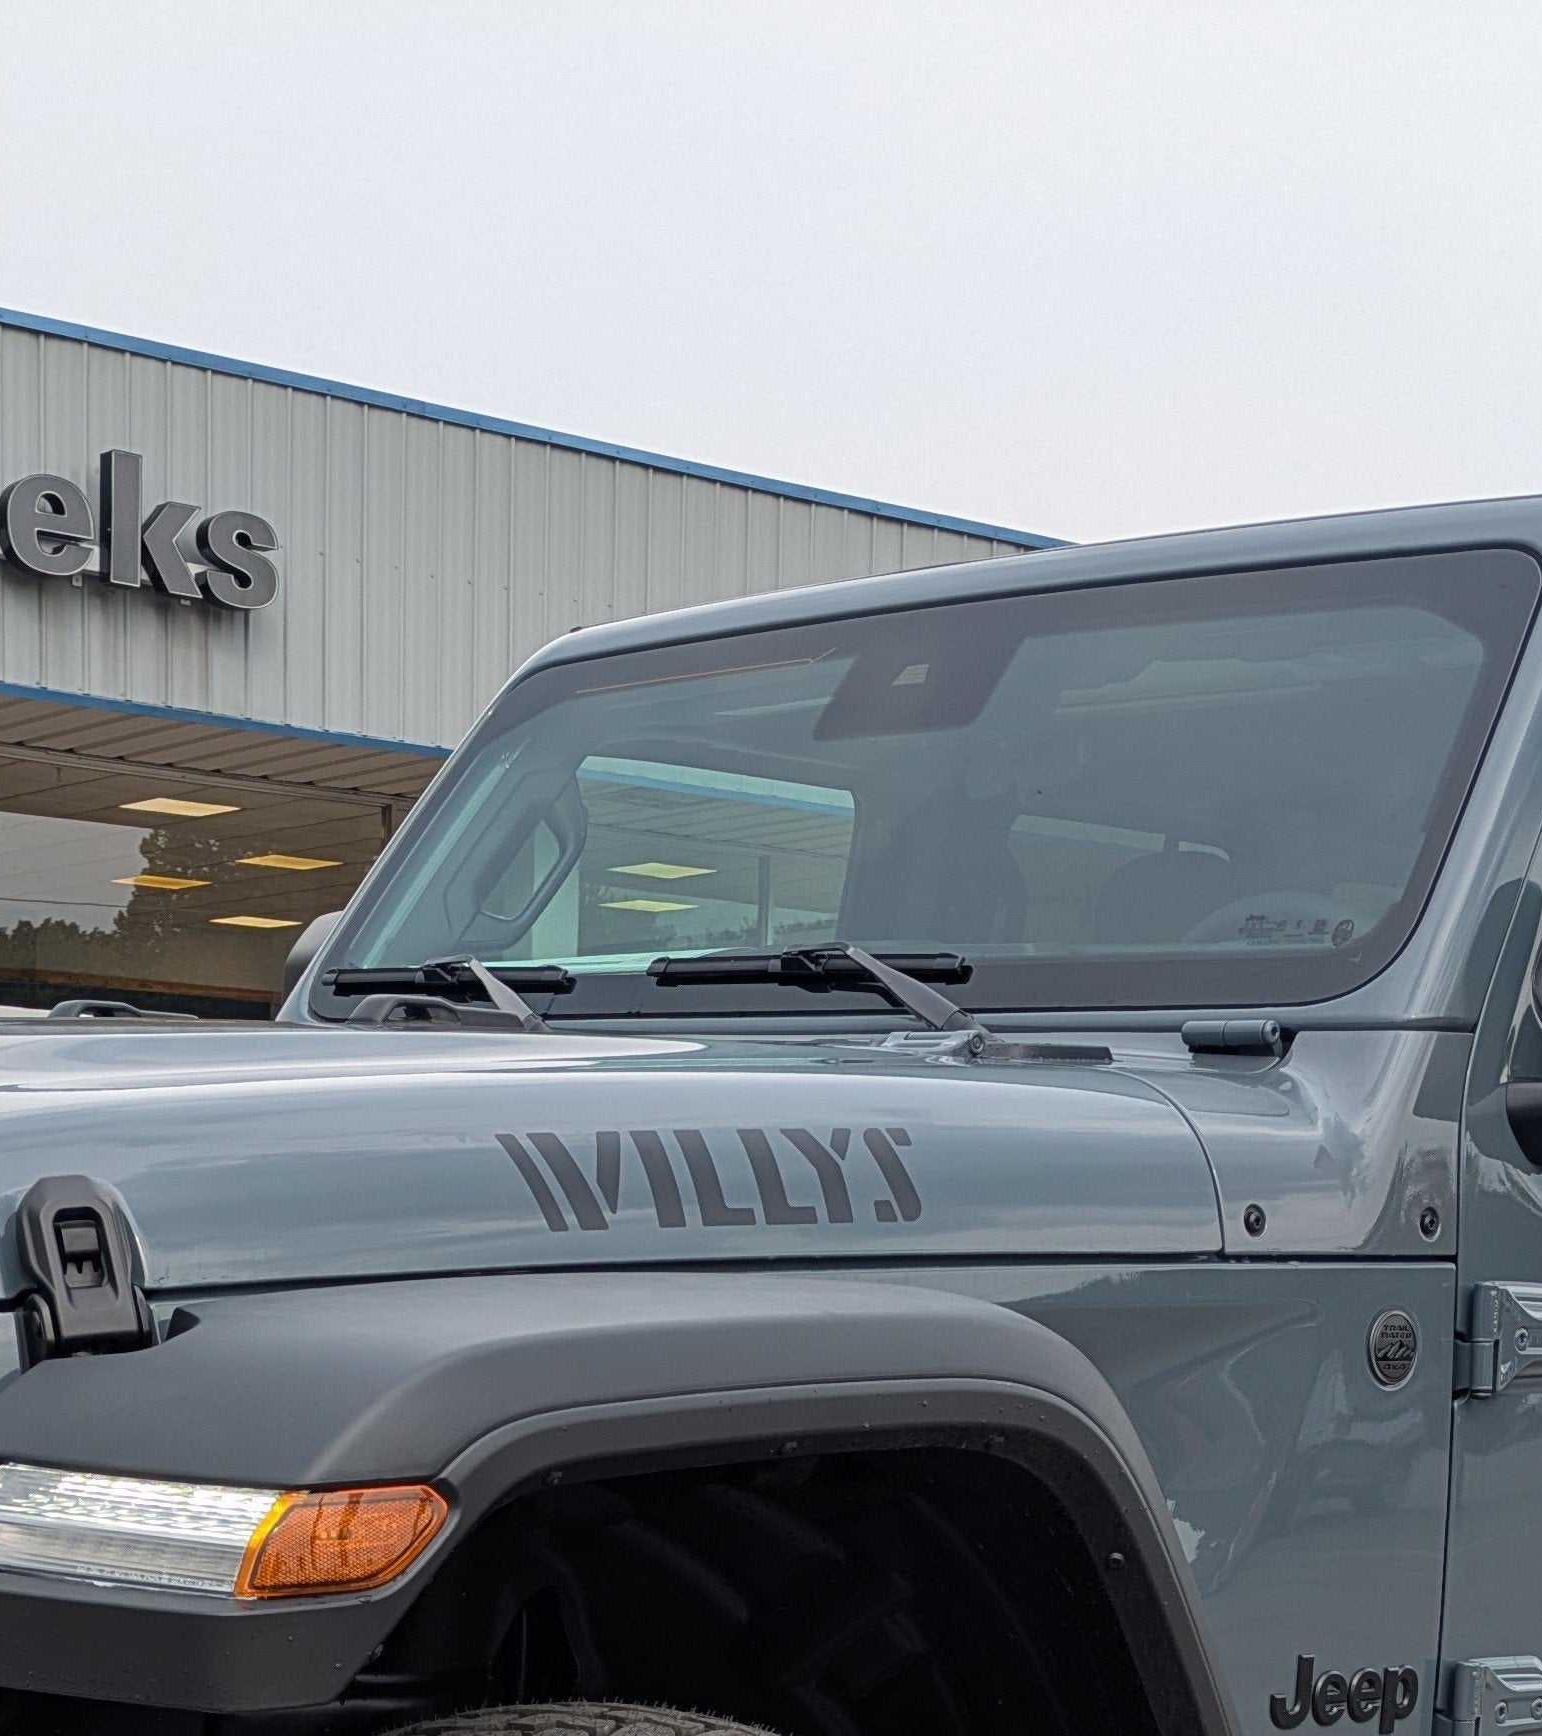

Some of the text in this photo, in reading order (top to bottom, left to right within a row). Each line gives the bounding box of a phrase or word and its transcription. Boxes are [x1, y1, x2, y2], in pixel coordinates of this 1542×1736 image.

[495, 1127, 922, 1232] WILLYS
[1380, 1331, 1412, 1339] RATED
[1384, 1324, 1409, 1332] TRAIL
[1270, 1653, 1419, 1735] Jeep
